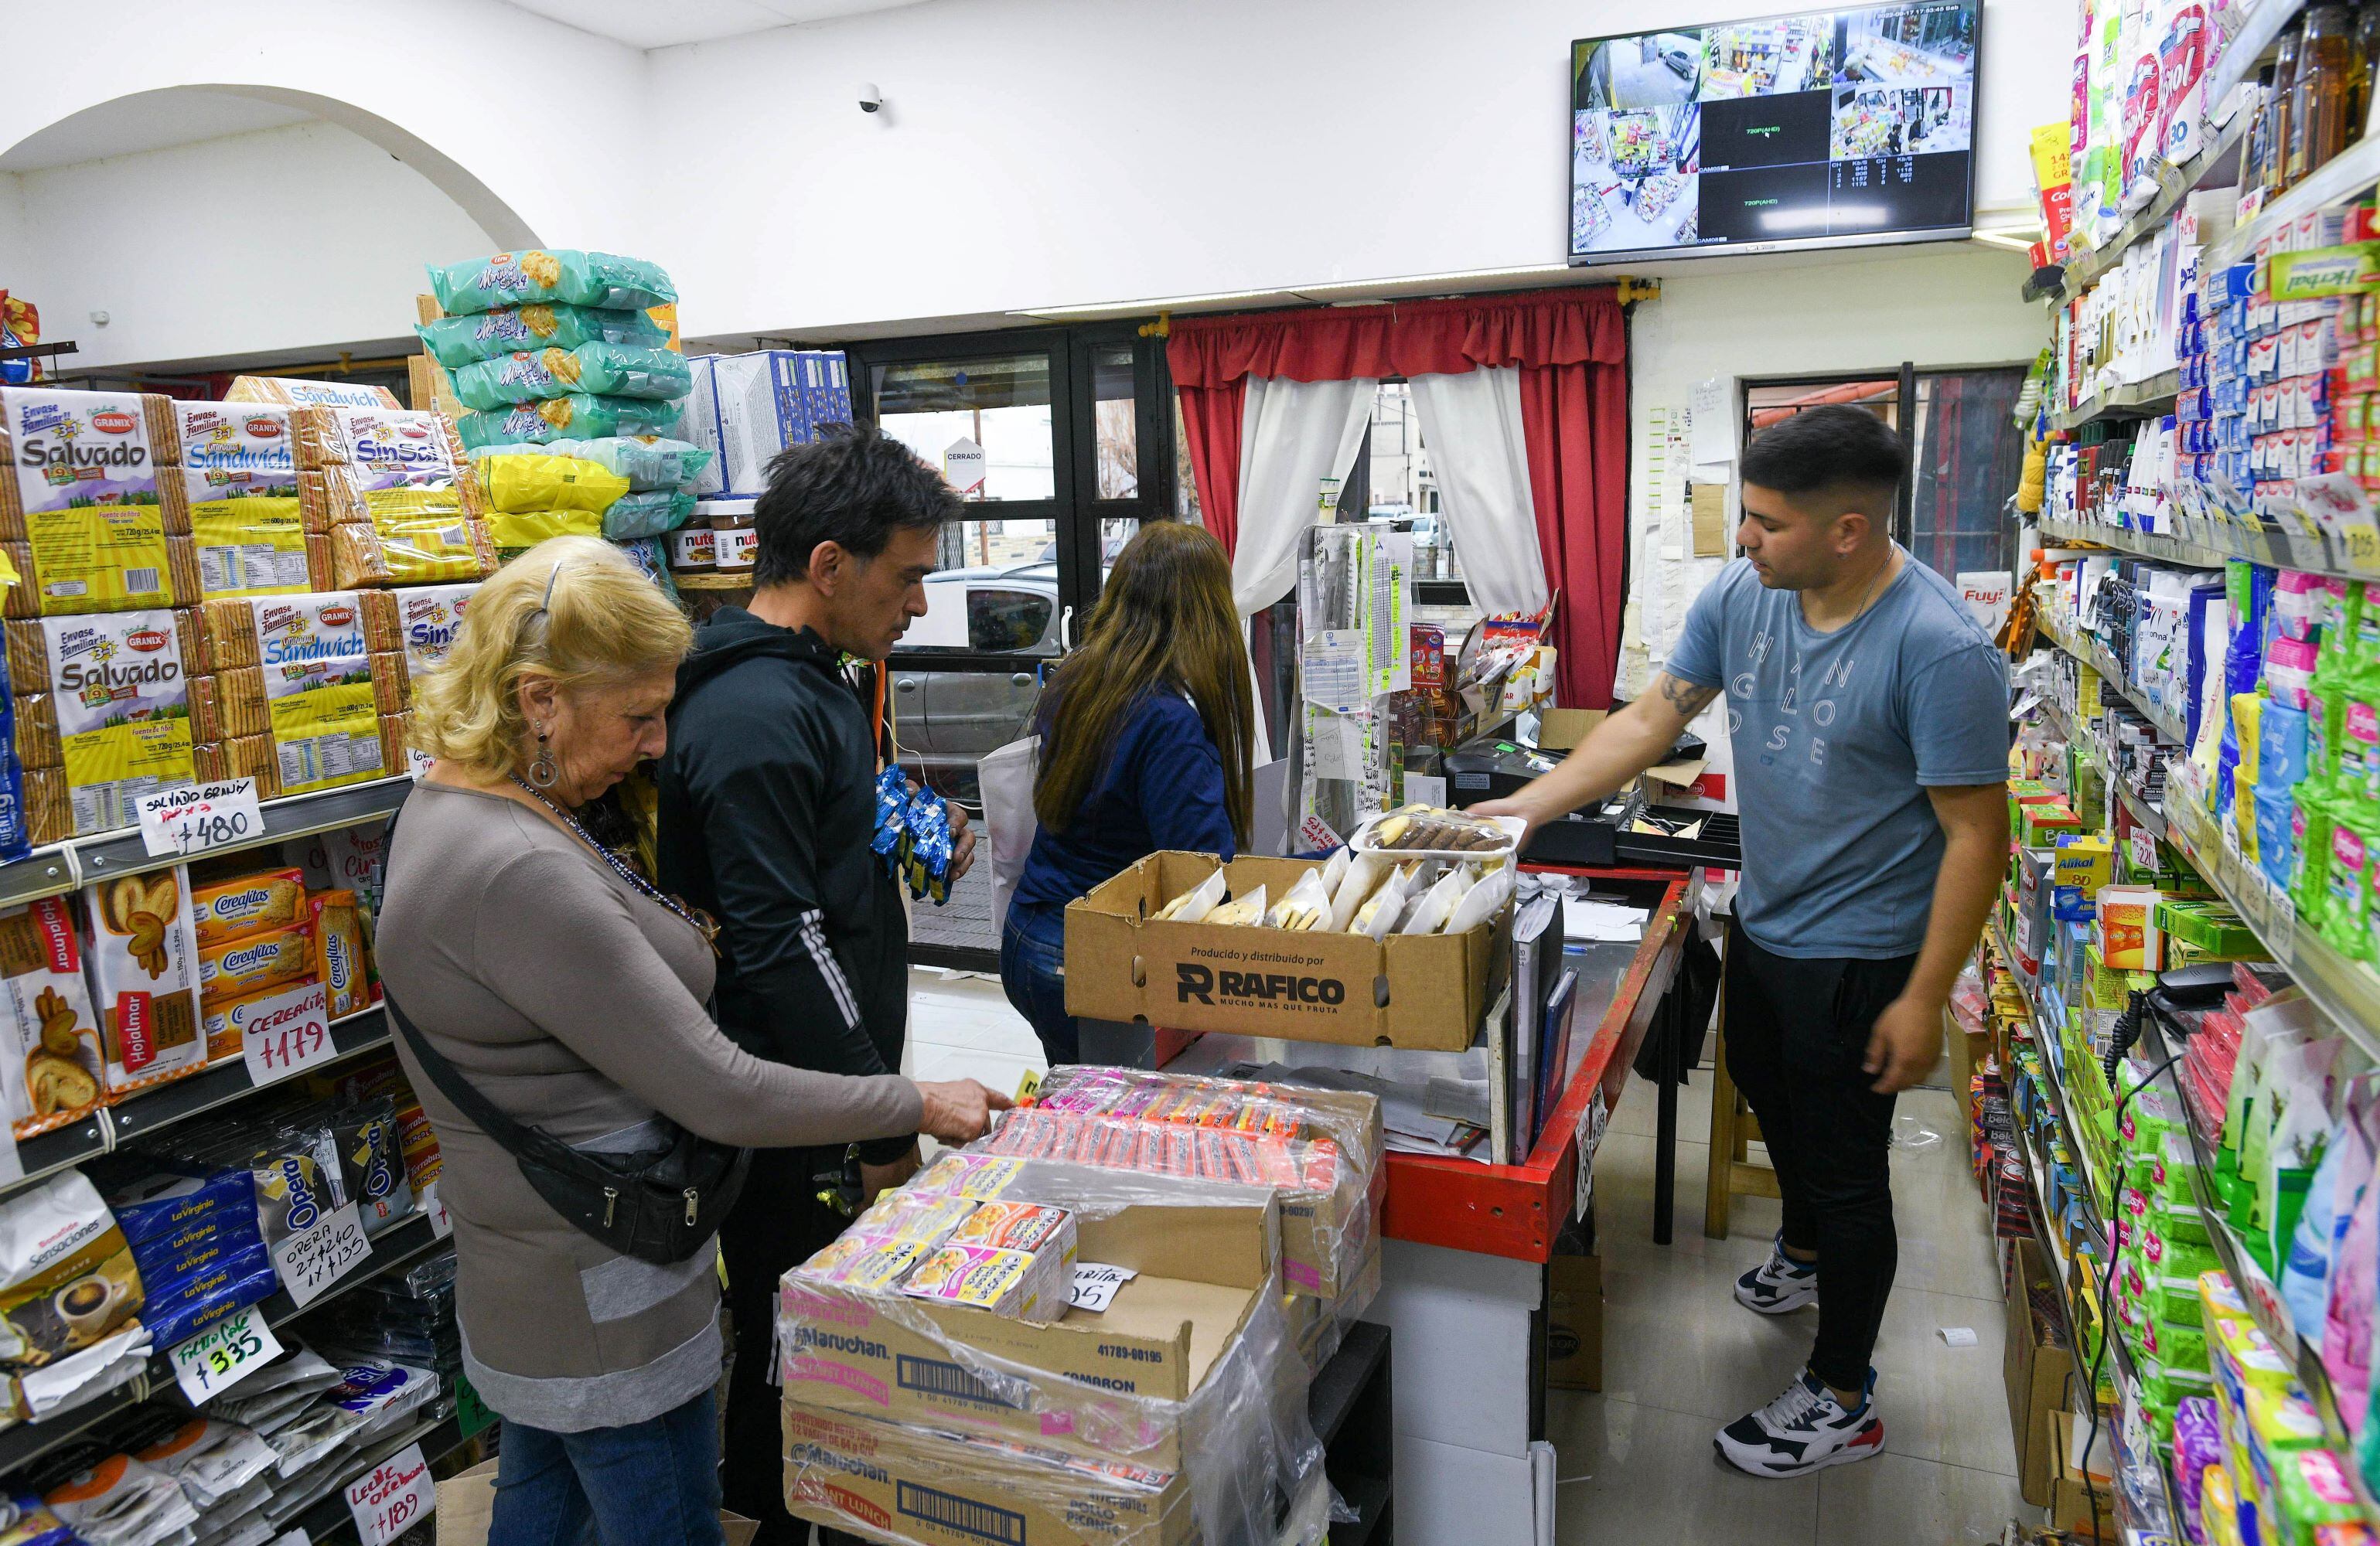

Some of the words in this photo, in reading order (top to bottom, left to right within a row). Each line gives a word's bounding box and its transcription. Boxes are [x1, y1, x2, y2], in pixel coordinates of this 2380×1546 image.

[1746, 126, 1780, 135] 720P(AHD)
[2170, 121, 2187, 146] 30
[22, 404, 59, 418] Envase
[187, 410, 217, 423] Envase
[349, 415, 375, 426] Envase
[94, 418, 131, 428] GRANIX
[247, 424, 277, 433] GRANIX
[20, 439, 146, 466] Salvado
[187, 444, 291, 469] Sandwich
[685, 534, 714, 546] nute
[263, 604, 292, 620] Envase
[407, 597, 432, 611] Envase
[322, 612, 349, 621] GRANIX
[60, 627, 94, 644] Envase
[128, 635, 164, 646] GRANIX
[265, 632, 363, 665] Sandwich
[60, 658, 179, 692] Salvado
[146, 790, 200, 812] SALVADO
[179, 811, 248, 855] $480
[2058, 857, 2095, 869] Alikal
[2071, 874, 2092, 886] 80
[214, 890, 268, 914] Cerealitas
[41, 901, 69, 969] Hojalmar
[223, 943, 278, 971] Cerealitas
[329, 934, 346, 990] Cerealitas
[1192, 947, 1240, 959] Producido
[1242, 952, 1248, 962] y
[1250, 951, 1304, 965] distribuido
[1307, 957, 1325, 967] por
[1219, 970, 1345, 1005] RAFICO
[1220, 998, 1254, 1007] MUCHO
[1259, 1001, 1279, 1010] MAS
[1283, 1003, 1302, 1012] QUE
[1307, 1006, 1338, 1014] FRUTA
[132, 996, 147, 1063] Hojalmar
[408, 1152, 441, 1177] Terrabus
[283, 1158, 319, 1231] Opera
[29, 1220, 100, 1269] Sensaciones
[287, 1224, 331, 1263] OPERA
[196, 1329, 262, 1390] $335
[849, 1497, 889, 1529] LUNCH
[940, 1527, 965, 1540] 41789
